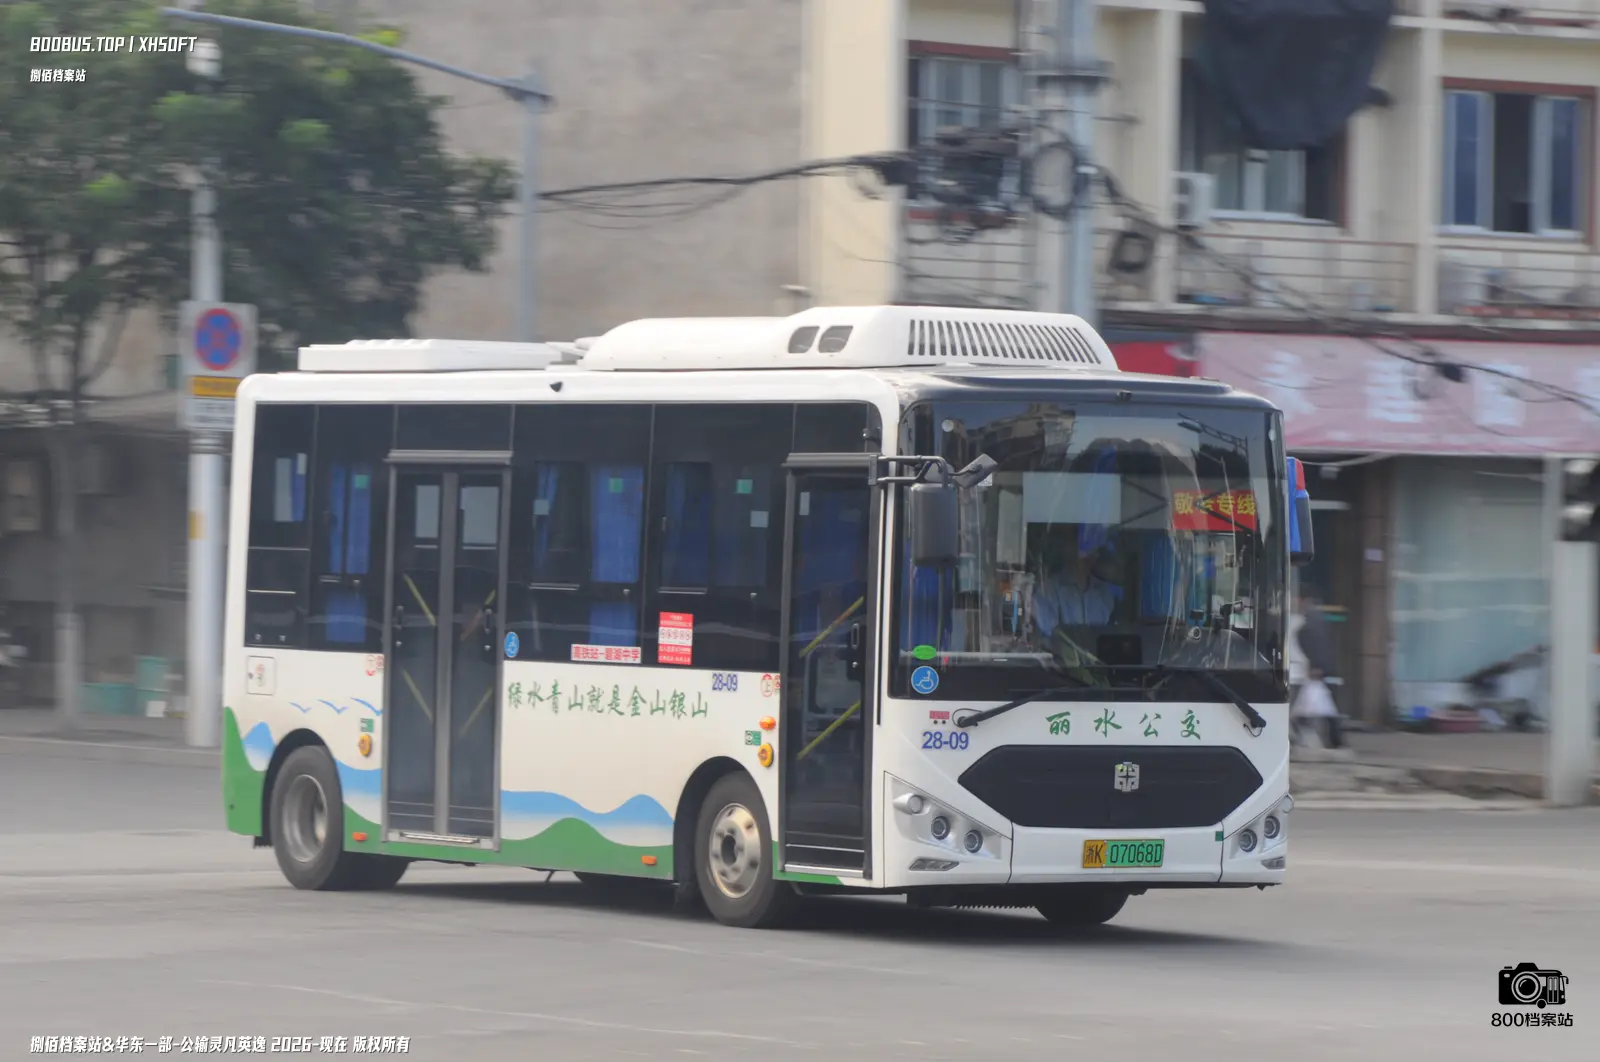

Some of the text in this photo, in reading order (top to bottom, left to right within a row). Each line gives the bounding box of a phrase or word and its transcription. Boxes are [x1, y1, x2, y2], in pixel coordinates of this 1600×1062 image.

[712, 673, 738, 692] 28-09
[508, 679, 708, 719] 绿水青山就是金山银山
[1045, 708, 1201, 740] 丽水公交
[922, 731, 969, 750] 28-09
